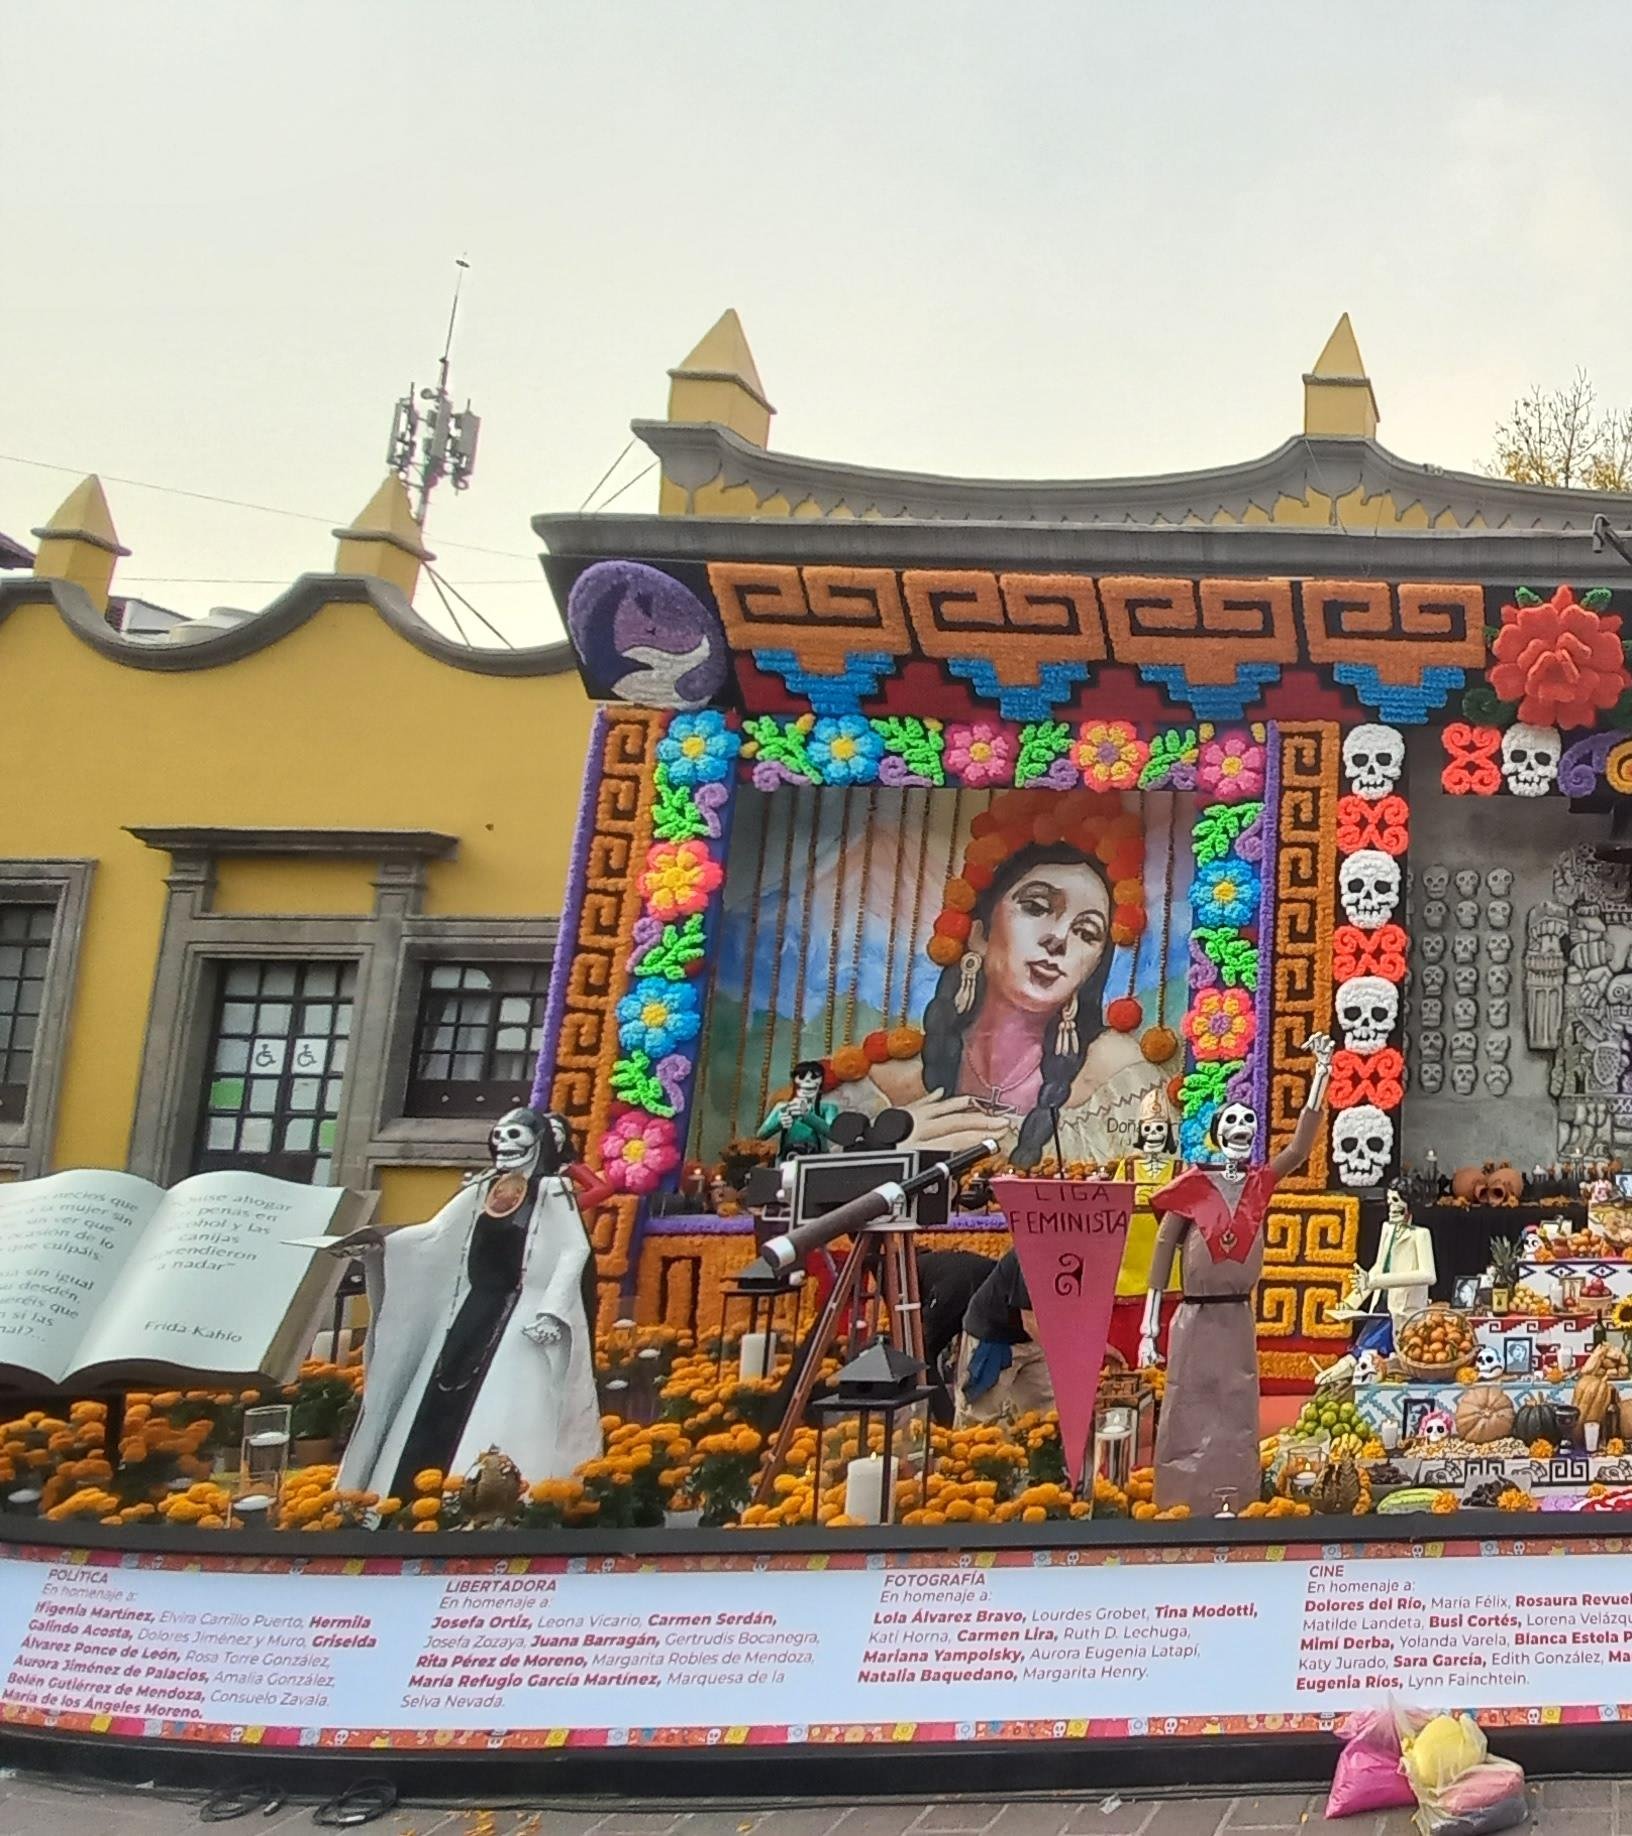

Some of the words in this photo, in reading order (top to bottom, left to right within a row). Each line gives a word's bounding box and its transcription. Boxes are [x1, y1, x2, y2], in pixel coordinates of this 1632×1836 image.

[1107, 1117, 1140, 1133] Doñ
[1036, 1185, 1110, 1202] LIGA
[60, 1203, 109, 1215] mujer
[110, 1197, 139, 1212] que
[233, 1194, 294, 1212] ahogar
[198, 1206, 250, 1217] penas
[255, 1213, 278, 1222] en
[1009, 1209, 1129, 1237] FEMINISTA
[84, 1219, 115, 1233] que
[248, 1222, 271, 1235] las
[100, 1238, 115, 1250] lo
[56, 1270, 95, 1291] igual
[31, 1311, 55, 1327] las
[50, 1303, 79, 1319] que
[144, 1321, 187, 1333] Frida
[192, 1326, 243, 1343] Kahlo
[48, 1569, 109, 1585] POLÍTICA
[884, 1571, 986, 1587] FOTOGRAFÍA
[1309, 1565, 1345, 1578] CINE
[446, 1578, 557, 1593] LIBERTADORA
[1305, 1599, 1365, 1612] Dolores
[1368, 1598, 1393, 1611] del
[1398, 1597, 1427, 1613] Río,
[1431, 1596, 1471, 1609] María
[1515, 1594, 1578, 1608] Rosaura
[431, 1615, 485, 1630] Josefa
[488, 1614, 533, 1630] Ortiz,
[537, 1614, 584, 1628] Leona
[647, 1613, 712, 1627] Carmen
[716, 1611, 777, 1628] Serdán,
[873, 1610, 907, 1624] Lola
[911, 1608, 972, 1624] Álvarez
[975, 1610, 1027, 1625] Bravo,
[1031, 1608, 1092, 1622] Lourdes
[1154, 1605, 1188, 1619] Tina
[1192, 1603, 1258, 1619] Modotti,
[1302, 1618, 1358, 1631] Matilde
[1361, 1617, 1425, 1631] Landeta,
[1429, 1615, 1464, 1629] Busi
[1467, 1613, 1523, 1629] Cortés,
[1526, 1613, 1576, 1627] Lorena
[28, 1618, 79, 1636] Galindo
[82, 1623, 134, 1641] Acosta,
[311, 1633, 377, 1649] Griselda
[423, 1635, 469, 1650] Josefa
[531, 1633, 579, 1648] Juana
[582, 1633, 661, 1650] Barragán,
[664, 1631, 734, 1646] Gertrudis
[868, 1630, 899, 1644] Kati
[956, 1628, 1020, 1642] Carmen
[1023, 1627, 1059, 1643] Lira,
[1063, 1627, 1100, 1640] Ruth
[1103, 1626, 1119, 1640] D.
[1122, 1626, 1192, 1643] Lechuga,
[21, 1634, 71, 1656] Álvarez
[74, 1642, 115, 1657] Ponce
[118, 1644, 138, 1659] de
[141, 1644, 180, 1663] León,
[224, 1650, 259, 1666] Torre
[1299, 1657, 1332, 1672] Katy
[1335, 1655, 1389, 1670] Jurado,
[1393, 1655, 1429, 1668] Sara
[1432, 1653, 1487, 1669] García,
[1491, 1652, 1531, 1666] Edith
[1534, 1651, 1603, 1666] González,
[858, 1669, 917, 1684] Natalia
[920, 1667, 1018, 1685] Baquedano,
[1022, 1665, 1097, 1683] Margarita
[1100, 1665, 1149, 1683] Henry.
[1296, 1676, 1362, 1692] Eugenia
[1365, 1674, 1404, 1690] Ríos,
[1408, 1674, 1444, 1689] Lynn
[1447, 1672, 1530, 1687] Fainchtein.
